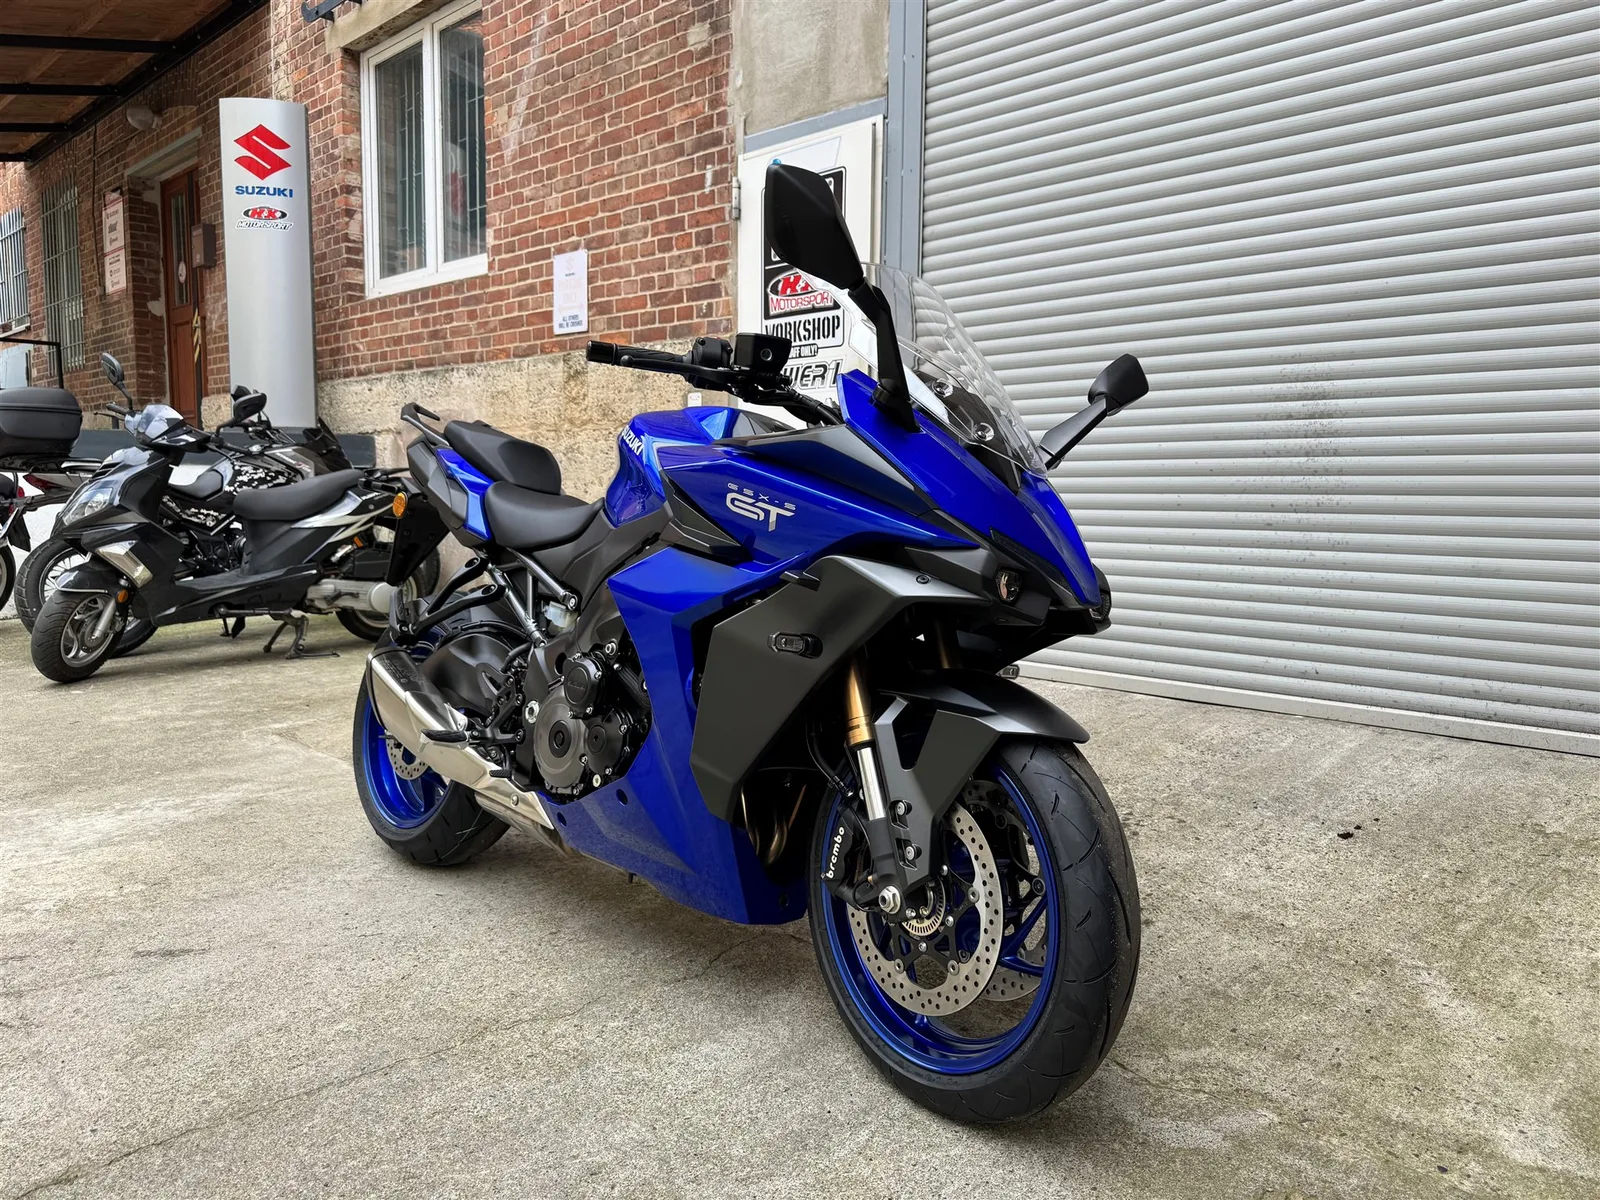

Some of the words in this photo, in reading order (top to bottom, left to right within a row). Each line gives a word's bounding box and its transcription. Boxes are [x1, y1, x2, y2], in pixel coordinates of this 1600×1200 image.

[235, 186, 293, 198] SUZUKI
[236, 220, 293, 231] MOTORSPORT
[765, 315, 840, 342] WORKSHOP
[789, 346, 800, 359] AFF
[801, 344, 817, 357] ONLY!
[782, 361, 841, 388] WER1
[621, 425, 644, 456] SUZUKI
[727, 483, 796, 510] GSX-S
[726, 493, 795, 531] GT
[826, 826, 845, 879] brembo
